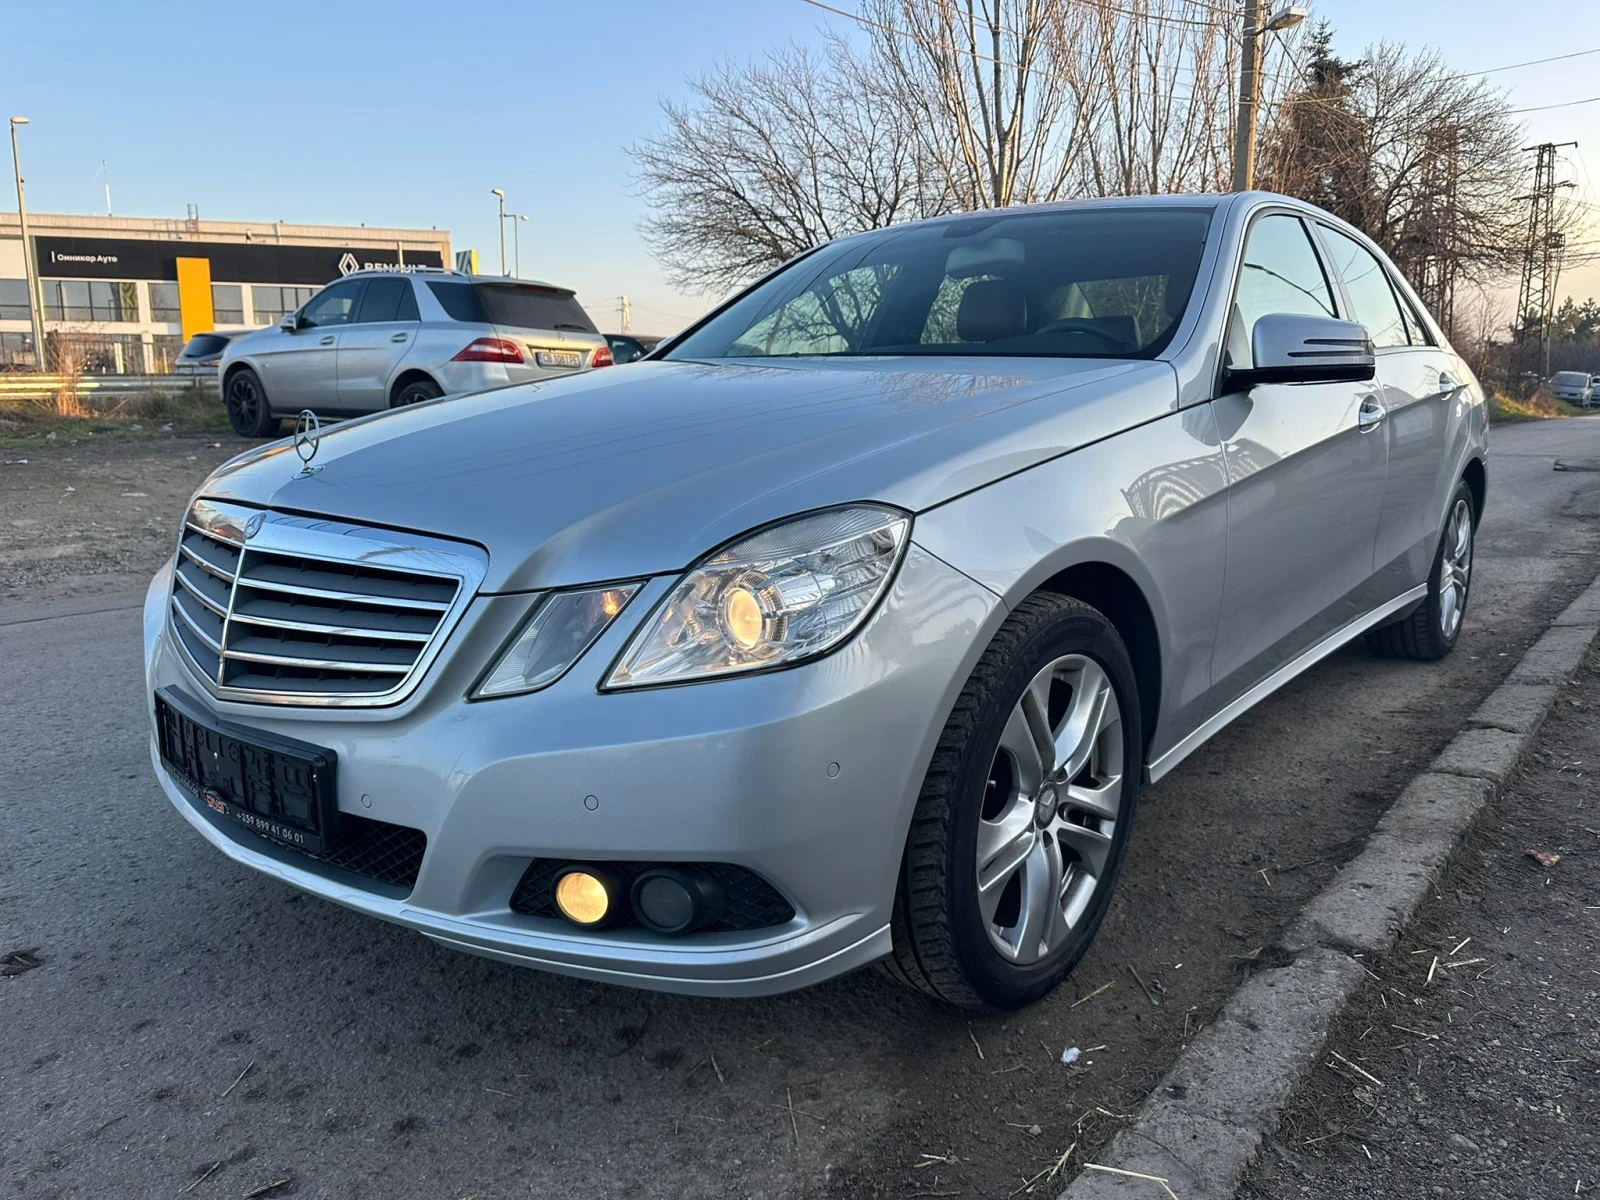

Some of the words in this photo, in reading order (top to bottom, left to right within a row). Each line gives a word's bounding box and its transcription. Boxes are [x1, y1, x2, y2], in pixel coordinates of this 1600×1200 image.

[57, 253, 96, 263] Омникар
[97, 254, 118, 264] Ауто
[236, 812, 254, 825] +359
[255, 819, 270, 831] 899
[271, 825, 280, 836] 41
[282, 829, 293, 840] 06
[294, 834, 304, 844] 01
